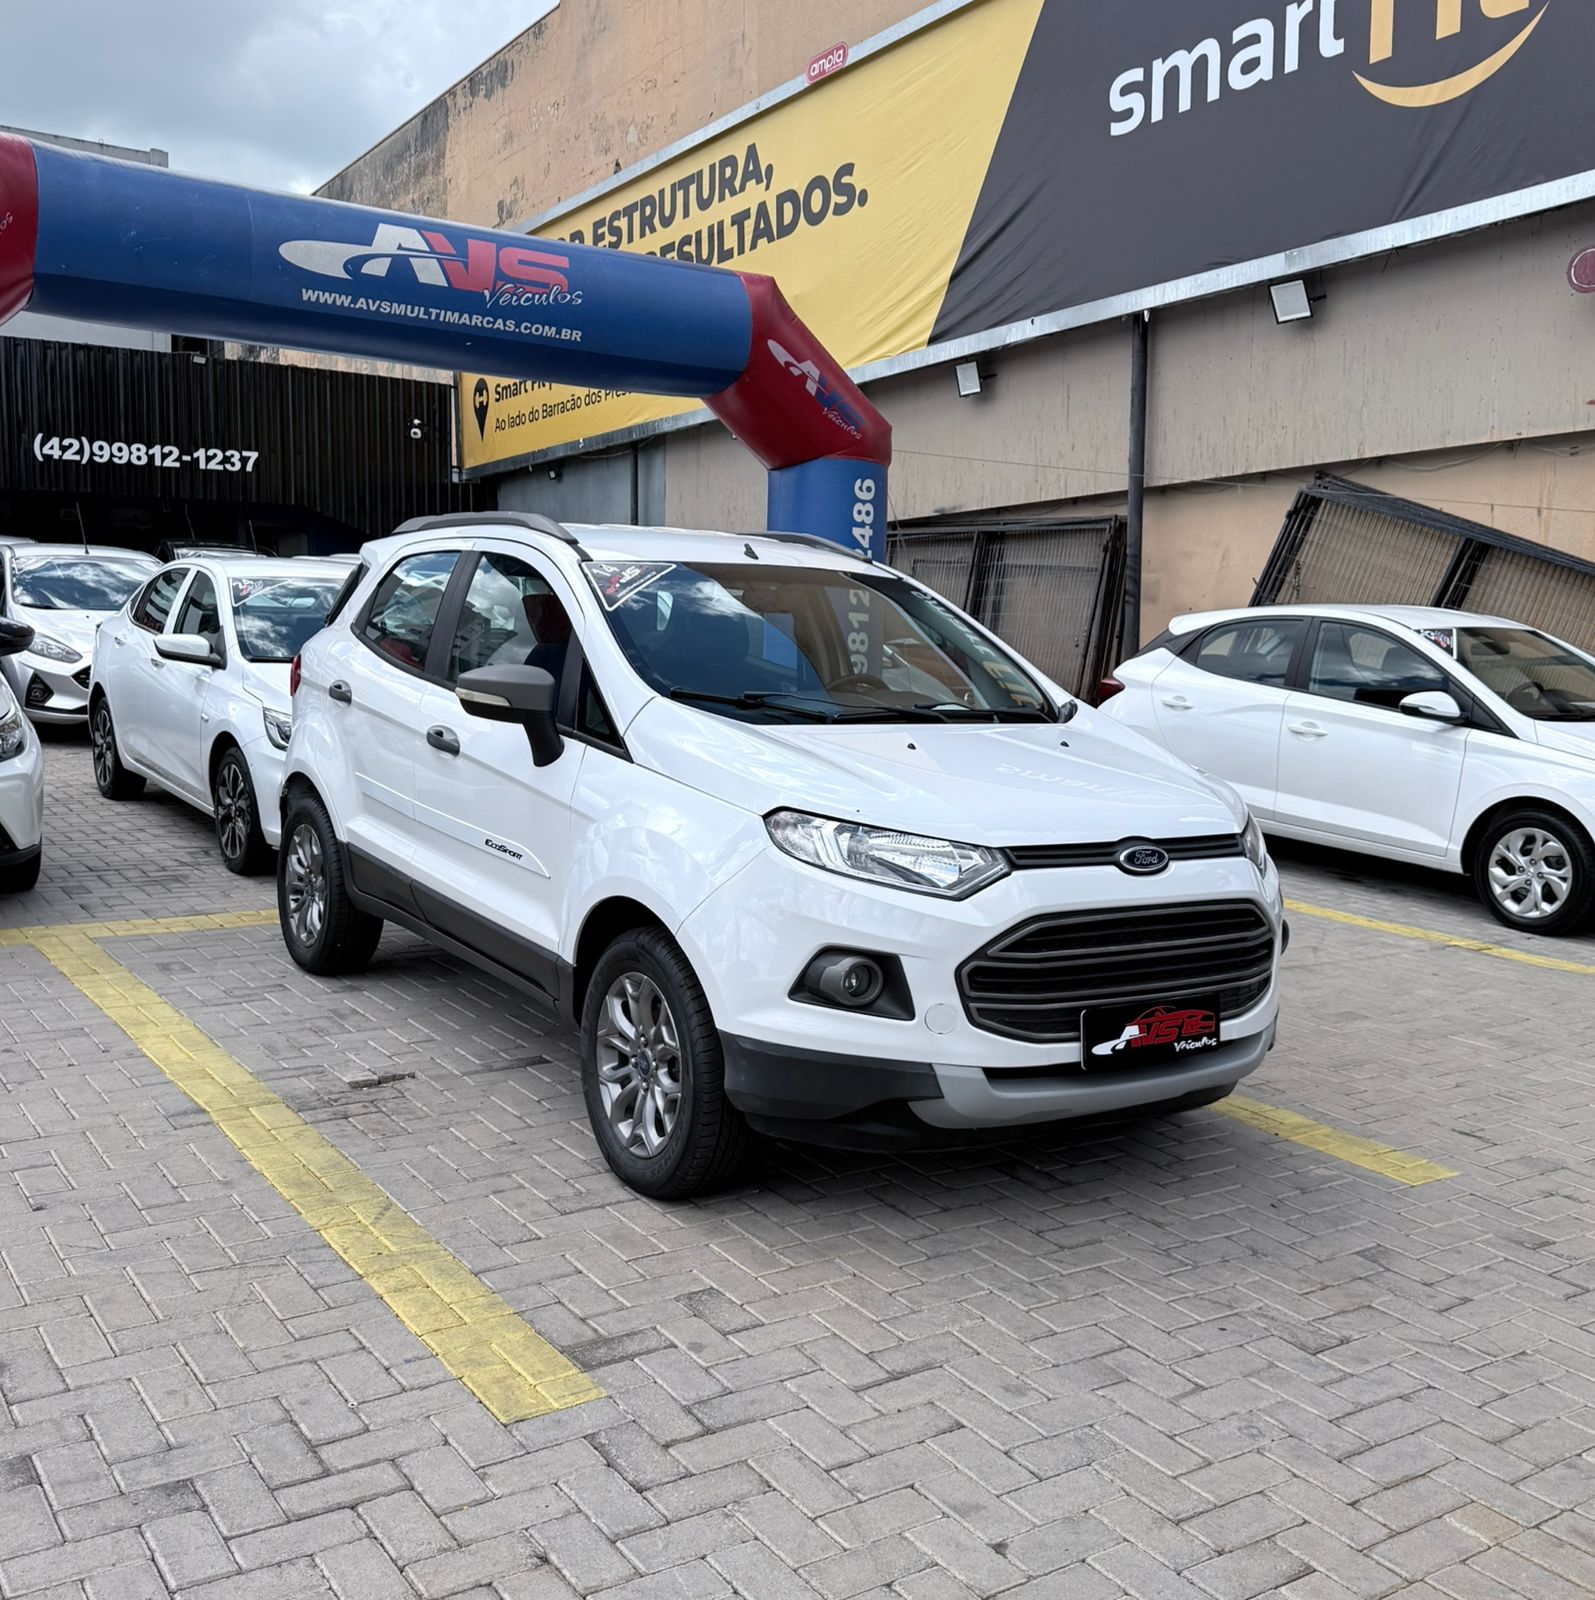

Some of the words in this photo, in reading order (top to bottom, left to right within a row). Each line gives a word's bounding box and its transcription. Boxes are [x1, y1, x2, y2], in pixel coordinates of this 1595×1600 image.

[811, 49, 844, 76] ampla
[592, 142, 774, 250] ESTRUTURA,
[645, 162, 869, 266] SULTADOS.
[279, 222, 570, 295] AVS
[301, 288, 582, 342] WWW.AVSMULTIMARCAS.COM.BR
[482, 283, 584, 309] Veículos
[494, 380, 528, 403] Smart
[495, 417, 507, 433] Ao
[507, 410, 527, 430] lado
[528, 406, 540, 423] do
[542, 393, 583, 420] Barracão
[584, 389, 602, 407] dos
[33, 432, 260, 473] (42)99812-1237
[1134, 850, 1160, 865] Ford
